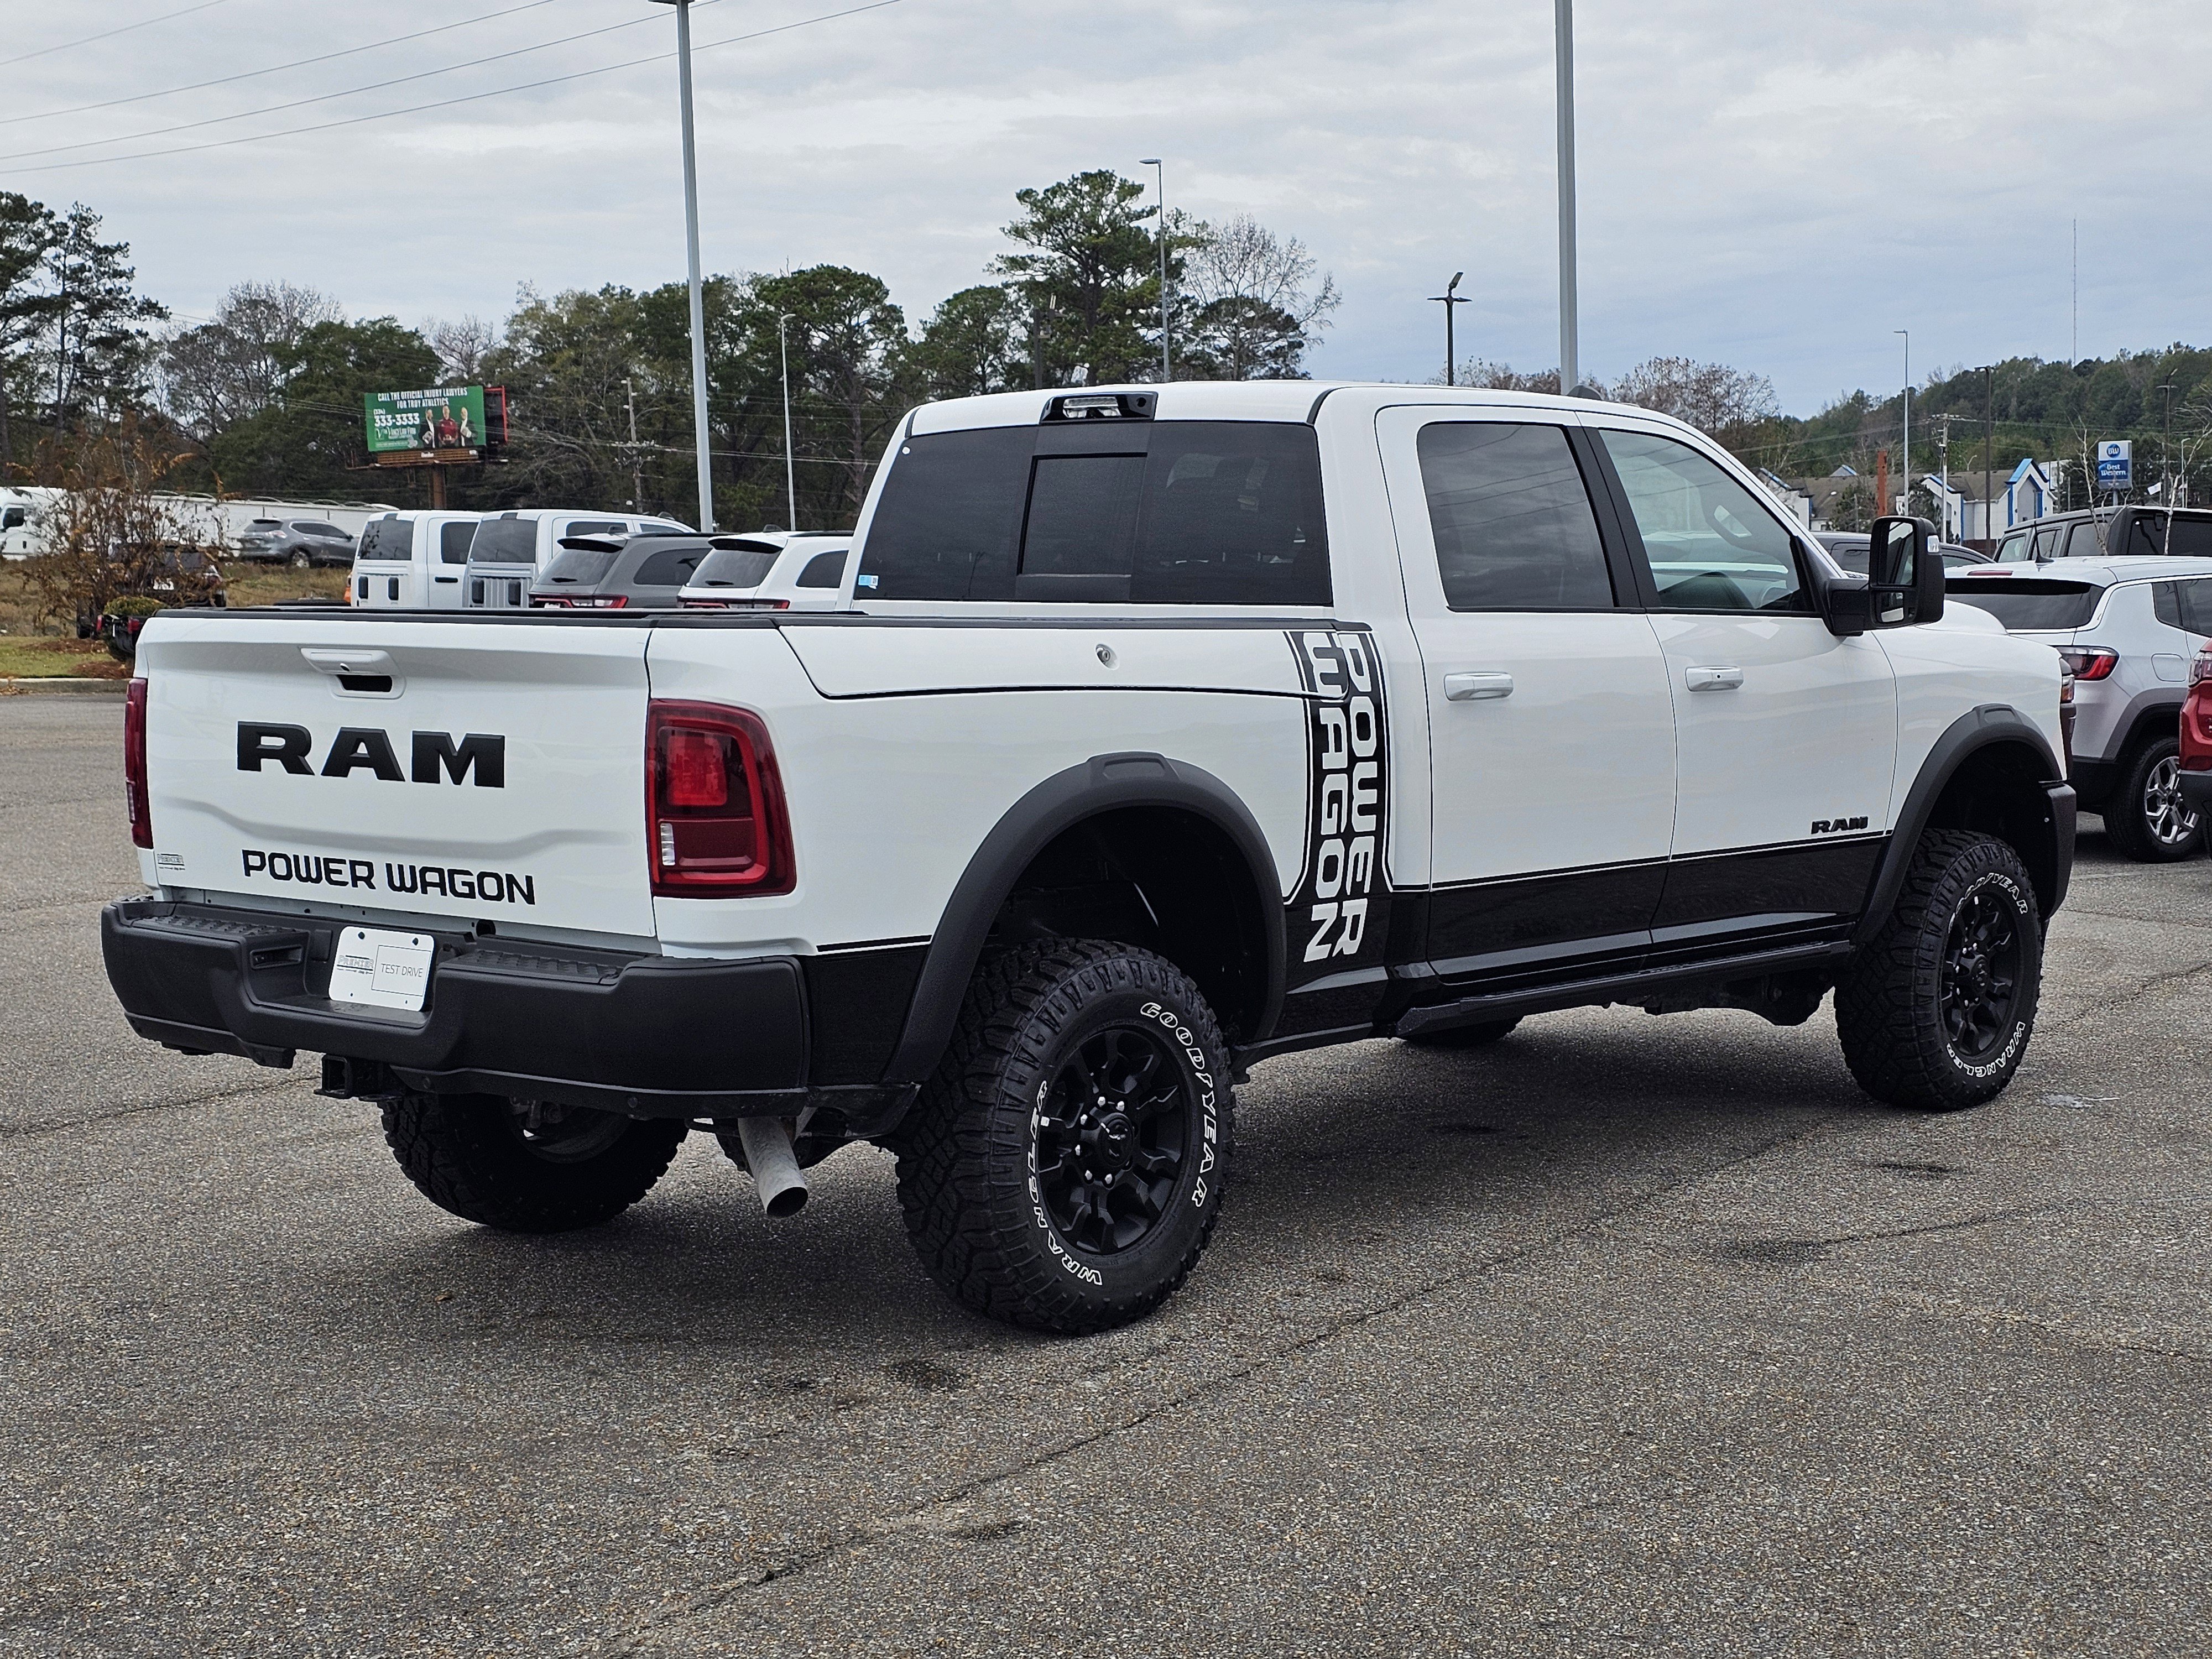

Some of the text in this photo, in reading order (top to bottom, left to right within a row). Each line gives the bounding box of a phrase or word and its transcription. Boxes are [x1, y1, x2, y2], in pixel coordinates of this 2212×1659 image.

[378, 387, 467, 401] CALL THE OFFICIAL INJURY LAWYERS
[397, 397, 449, 409] FOR TROY ATHLETICS
[374, 413, 420, 427] 333-3333
[237, 721, 505, 788] RAM
[1303, 632, 1348, 963] WAGON
[1331, 633, 1378, 957] POWER
[1811, 816, 1868, 834] RAM
[242, 849, 535, 905] POWER WAGON
[337, 955, 374, 969] PREMIER
[381, 963, 400, 975] TEST
[401, 966, 423, 978] DRIVE
[1140, 1002, 1217, 1207] GOODYEAR
